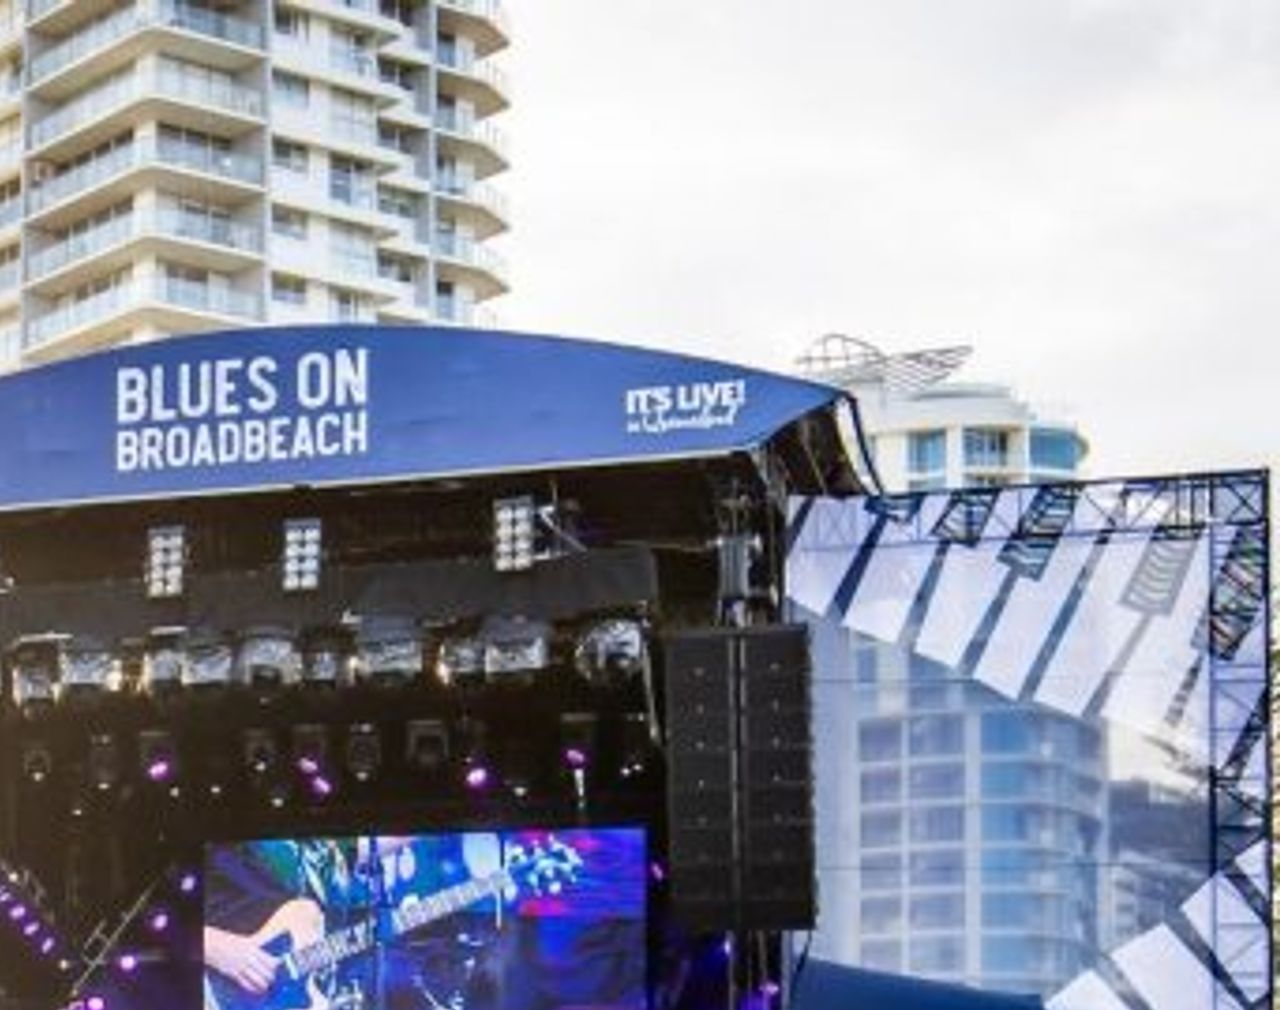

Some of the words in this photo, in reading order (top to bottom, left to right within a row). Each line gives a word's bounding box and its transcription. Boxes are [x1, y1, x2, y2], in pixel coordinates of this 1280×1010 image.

[117, 357, 277, 423] BLUES
[297, 347, 368, 408] ON
[677, 379, 745, 411] LIVE!
[116, 411, 368, 471] BROADBEACH
